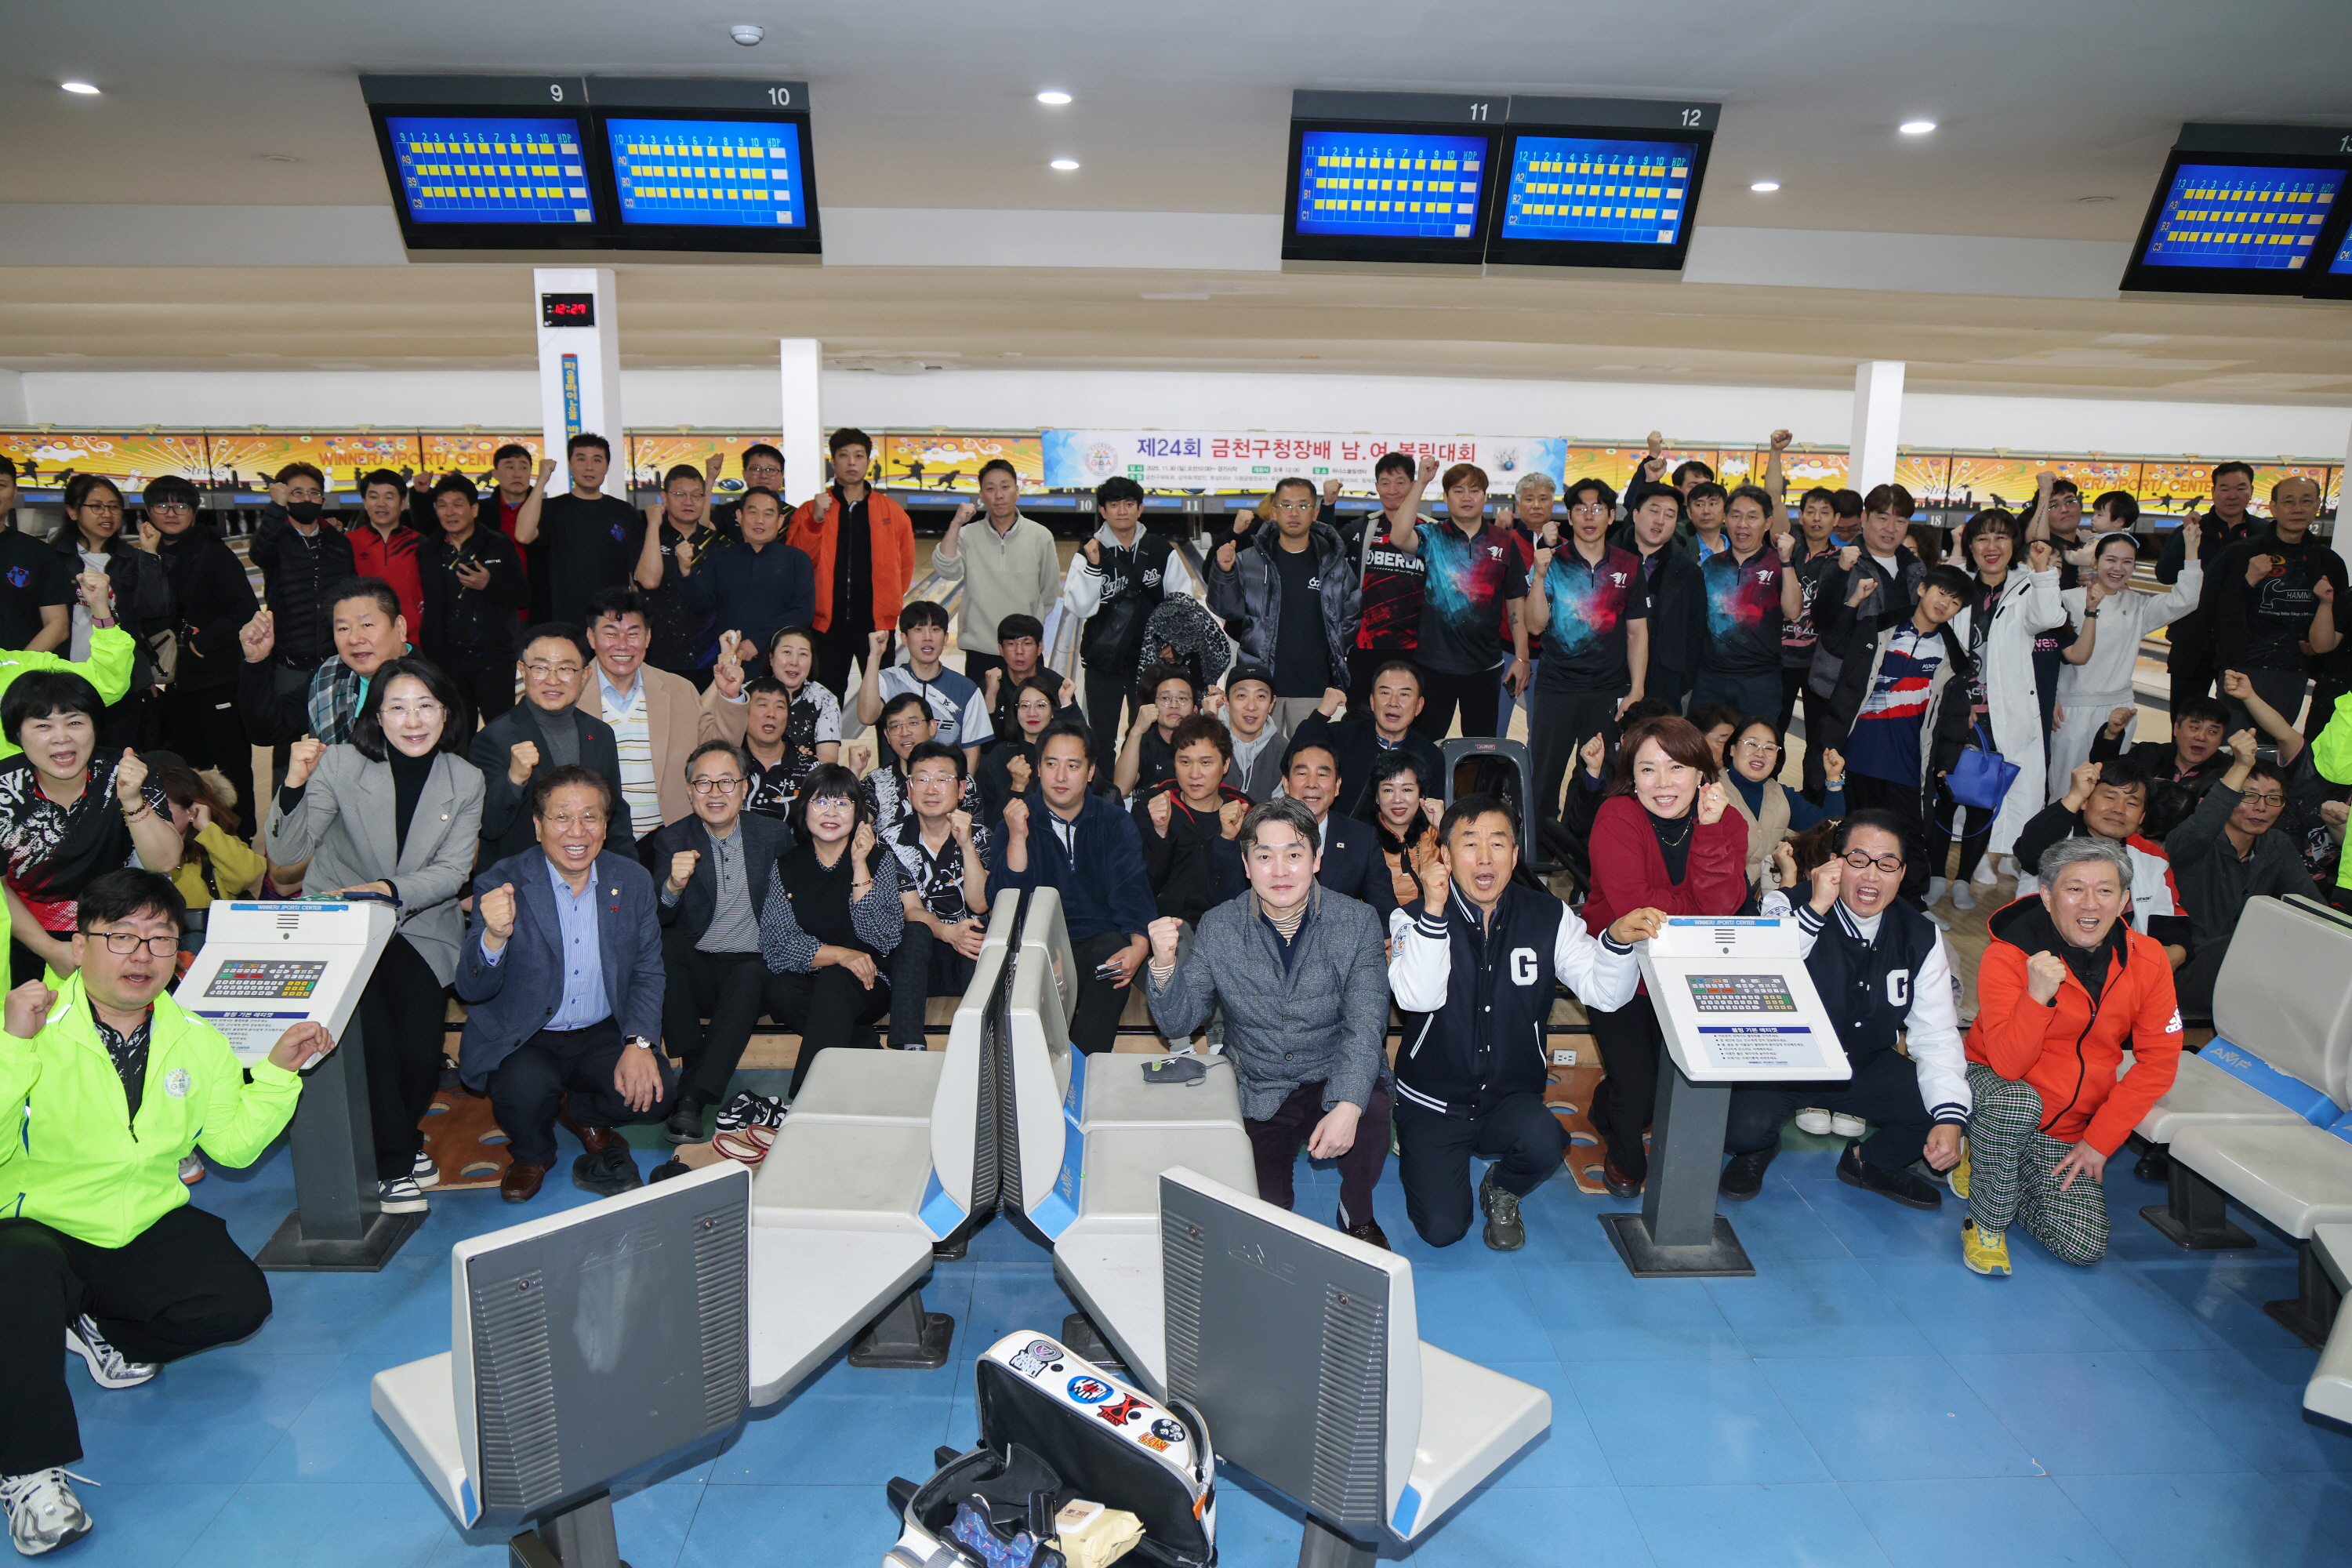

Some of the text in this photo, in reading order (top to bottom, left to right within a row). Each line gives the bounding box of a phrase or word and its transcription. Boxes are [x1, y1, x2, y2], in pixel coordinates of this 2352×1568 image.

[550, 85, 564, 102] 9
[768, 88, 789, 105] 10
[1471, 103, 1488, 121] 11
[1682, 109, 1701, 126] 12
[399, 132, 572, 143] 9 1 2 3 4 5 6 7 8 9 10 HDP
[614, 134, 781, 147] 10 1 2 3 4 5 6 7 8 9 10 HDP
[1307, 147, 1478, 161] 11 1 2 3 4 5 6 7 8 9 10 HDP
[1519, 151, 1686, 167] 12 1 2 3 4 5 6 7 8 9 10 HDP
[2177, 179, 2336, 193] 13 1 2 3 4 5 6 7 8 9 10 HDP
[1137, 437, 1475, 463] 제24회 금천구청장배 남.여 볼링대회
[318, 452, 495, 466] WINNERS SPORTS CENT
[1922, 484, 1961, 497] Strike
[2111, 477, 2163, 492] SPORTS
[2169, 479, 2214, 492] CENTE
[1079, 499, 1092, 510] 10
[1185, 499, 1199, 511] 11
[1929, 515, 1942, 526] 18
[1352, 532, 1359, 542] A
[2286, 591, 2314, 600] HAMME
[1782, 625, 1819, 636] ACKAL
[1510, 947, 1538, 986] G
[1886, 969, 1909, 1007] G
[2209, 1047, 2252, 1069] AMF
[1066, 1083, 1076, 1111] AMF
[1061, 1163, 1073, 1202] AMF
[1097, 1410, 1122, 1427] JAPAN
[1138, 1432, 1171, 1452] KISS
